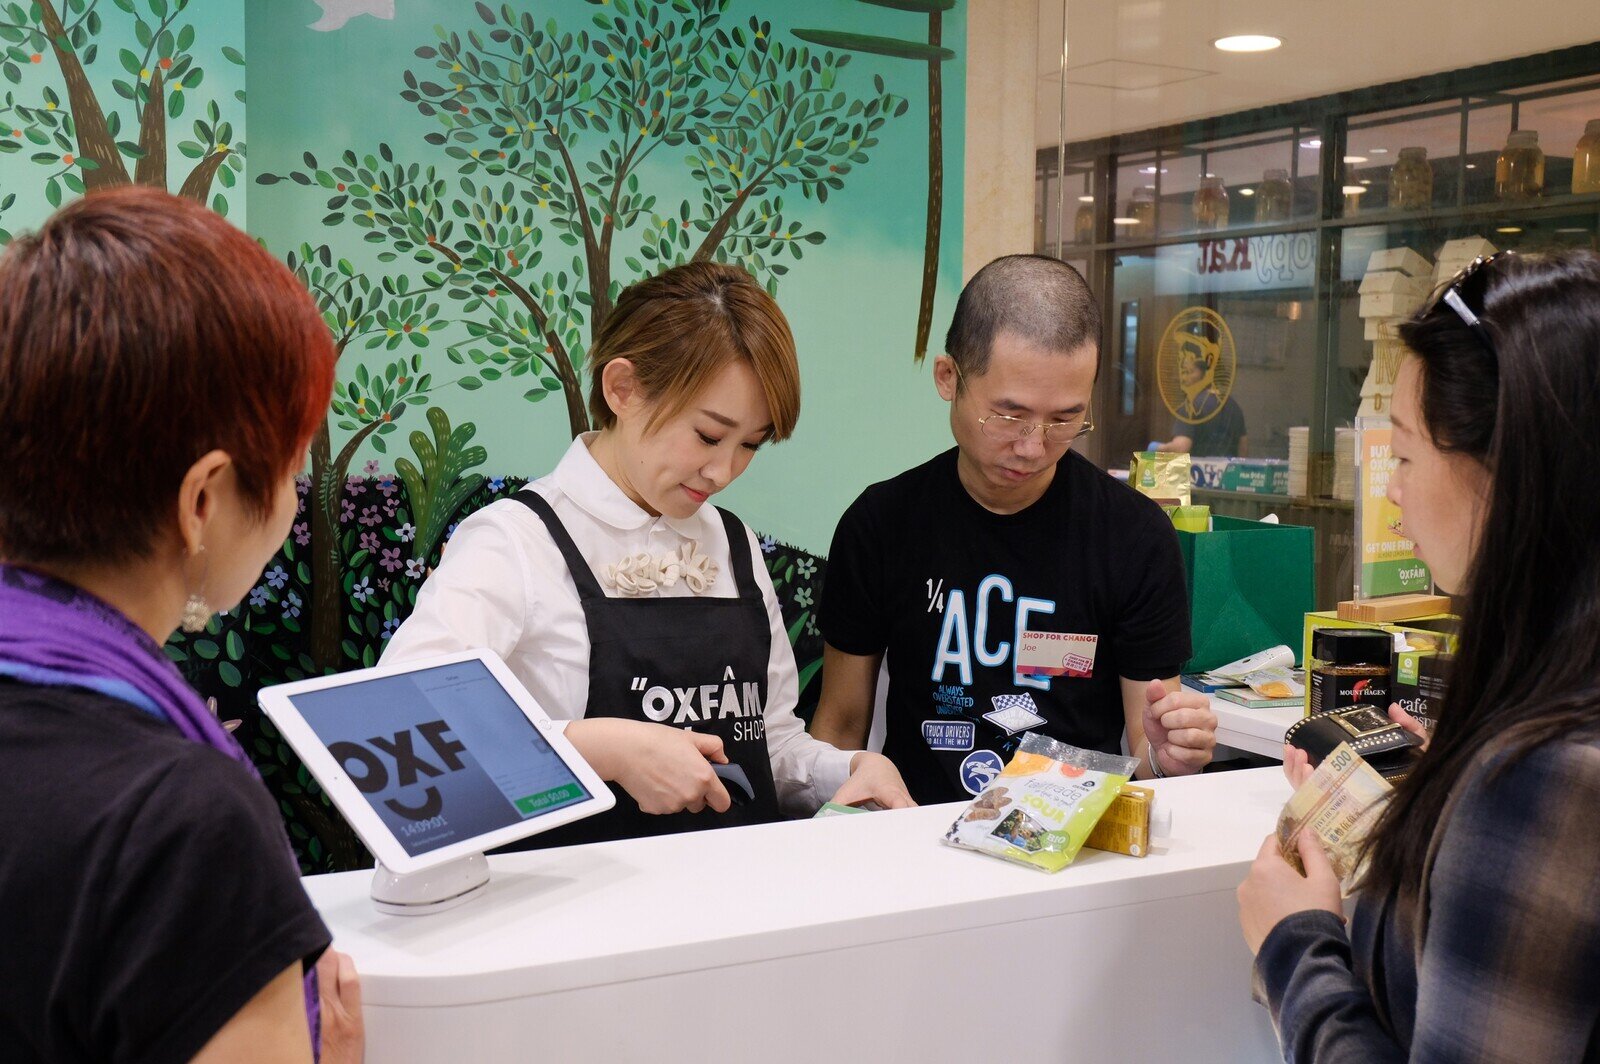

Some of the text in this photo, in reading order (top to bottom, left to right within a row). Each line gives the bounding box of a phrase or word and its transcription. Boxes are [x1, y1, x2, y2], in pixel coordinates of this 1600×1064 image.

[1370, 444, 1389, 458] BUY
[1366, 542, 1380, 553] GET
[1381, 541, 1397, 552] ONE
[931, 573, 1056, 691] ACE
[1022, 632, 1097, 643] SHOP FOR CHANGE
[1022, 643, 1037, 652] Joe
[938, 684, 964, 697] ALWAYS
[1398, 697, 1428, 715] café
[733, 720, 765, 742] SHOP
[925, 724, 971, 739] TRUCK DRIVERS
[945, 738, 955, 746] THE
[326, 719, 467, 793] OXF
[1330, 749, 1352, 772] 500
[1024, 778, 1082, 801] fairtrade
[528, 795, 548, 808] Total
[1046, 833, 1066, 844] BIO
